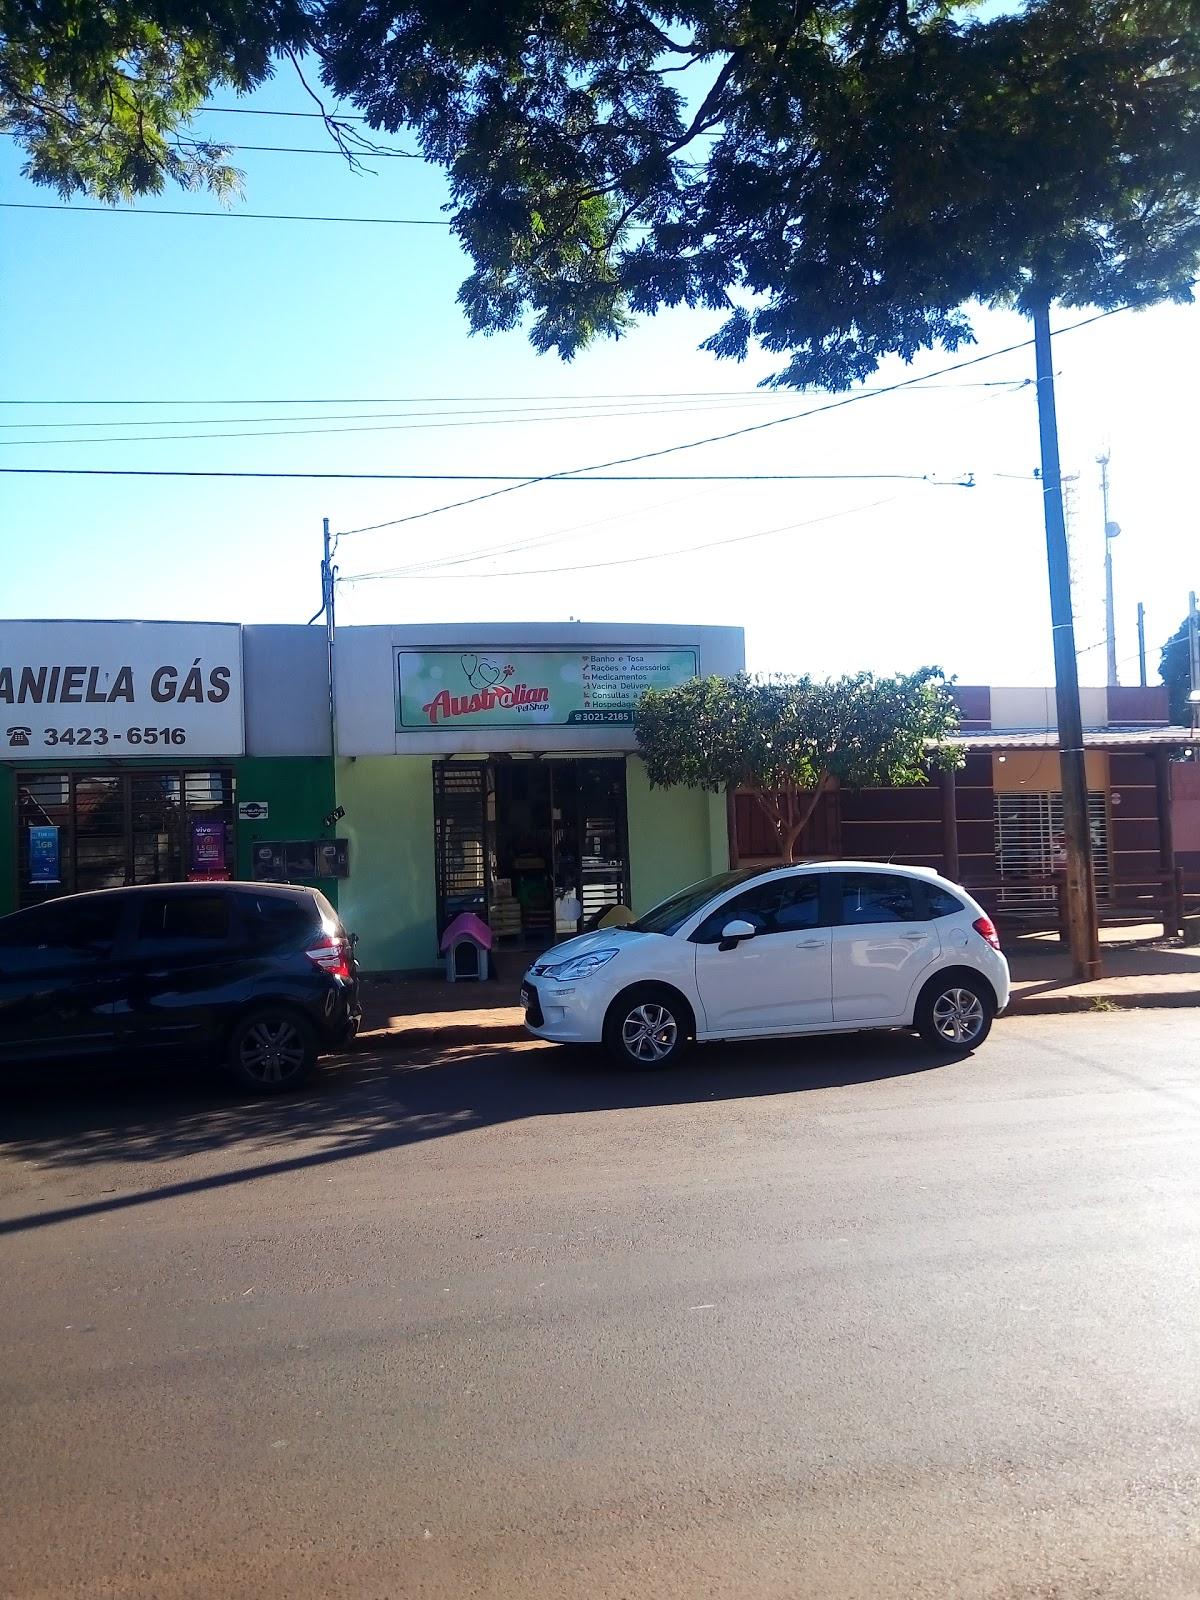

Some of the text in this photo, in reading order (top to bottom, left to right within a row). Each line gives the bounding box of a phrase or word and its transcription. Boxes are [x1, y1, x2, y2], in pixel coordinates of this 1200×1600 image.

[591, 664, 619, 672] Rações
[631, 663, 671, 671] Acessórios
[150, 657, 231, 703] GÁS
[591, 673, 647, 681] Medicamentos
[592, 691, 630, 699] Consultas
[422, 683, 549, 724] Australian
[583, 712, 629, 721] 3021-2185
